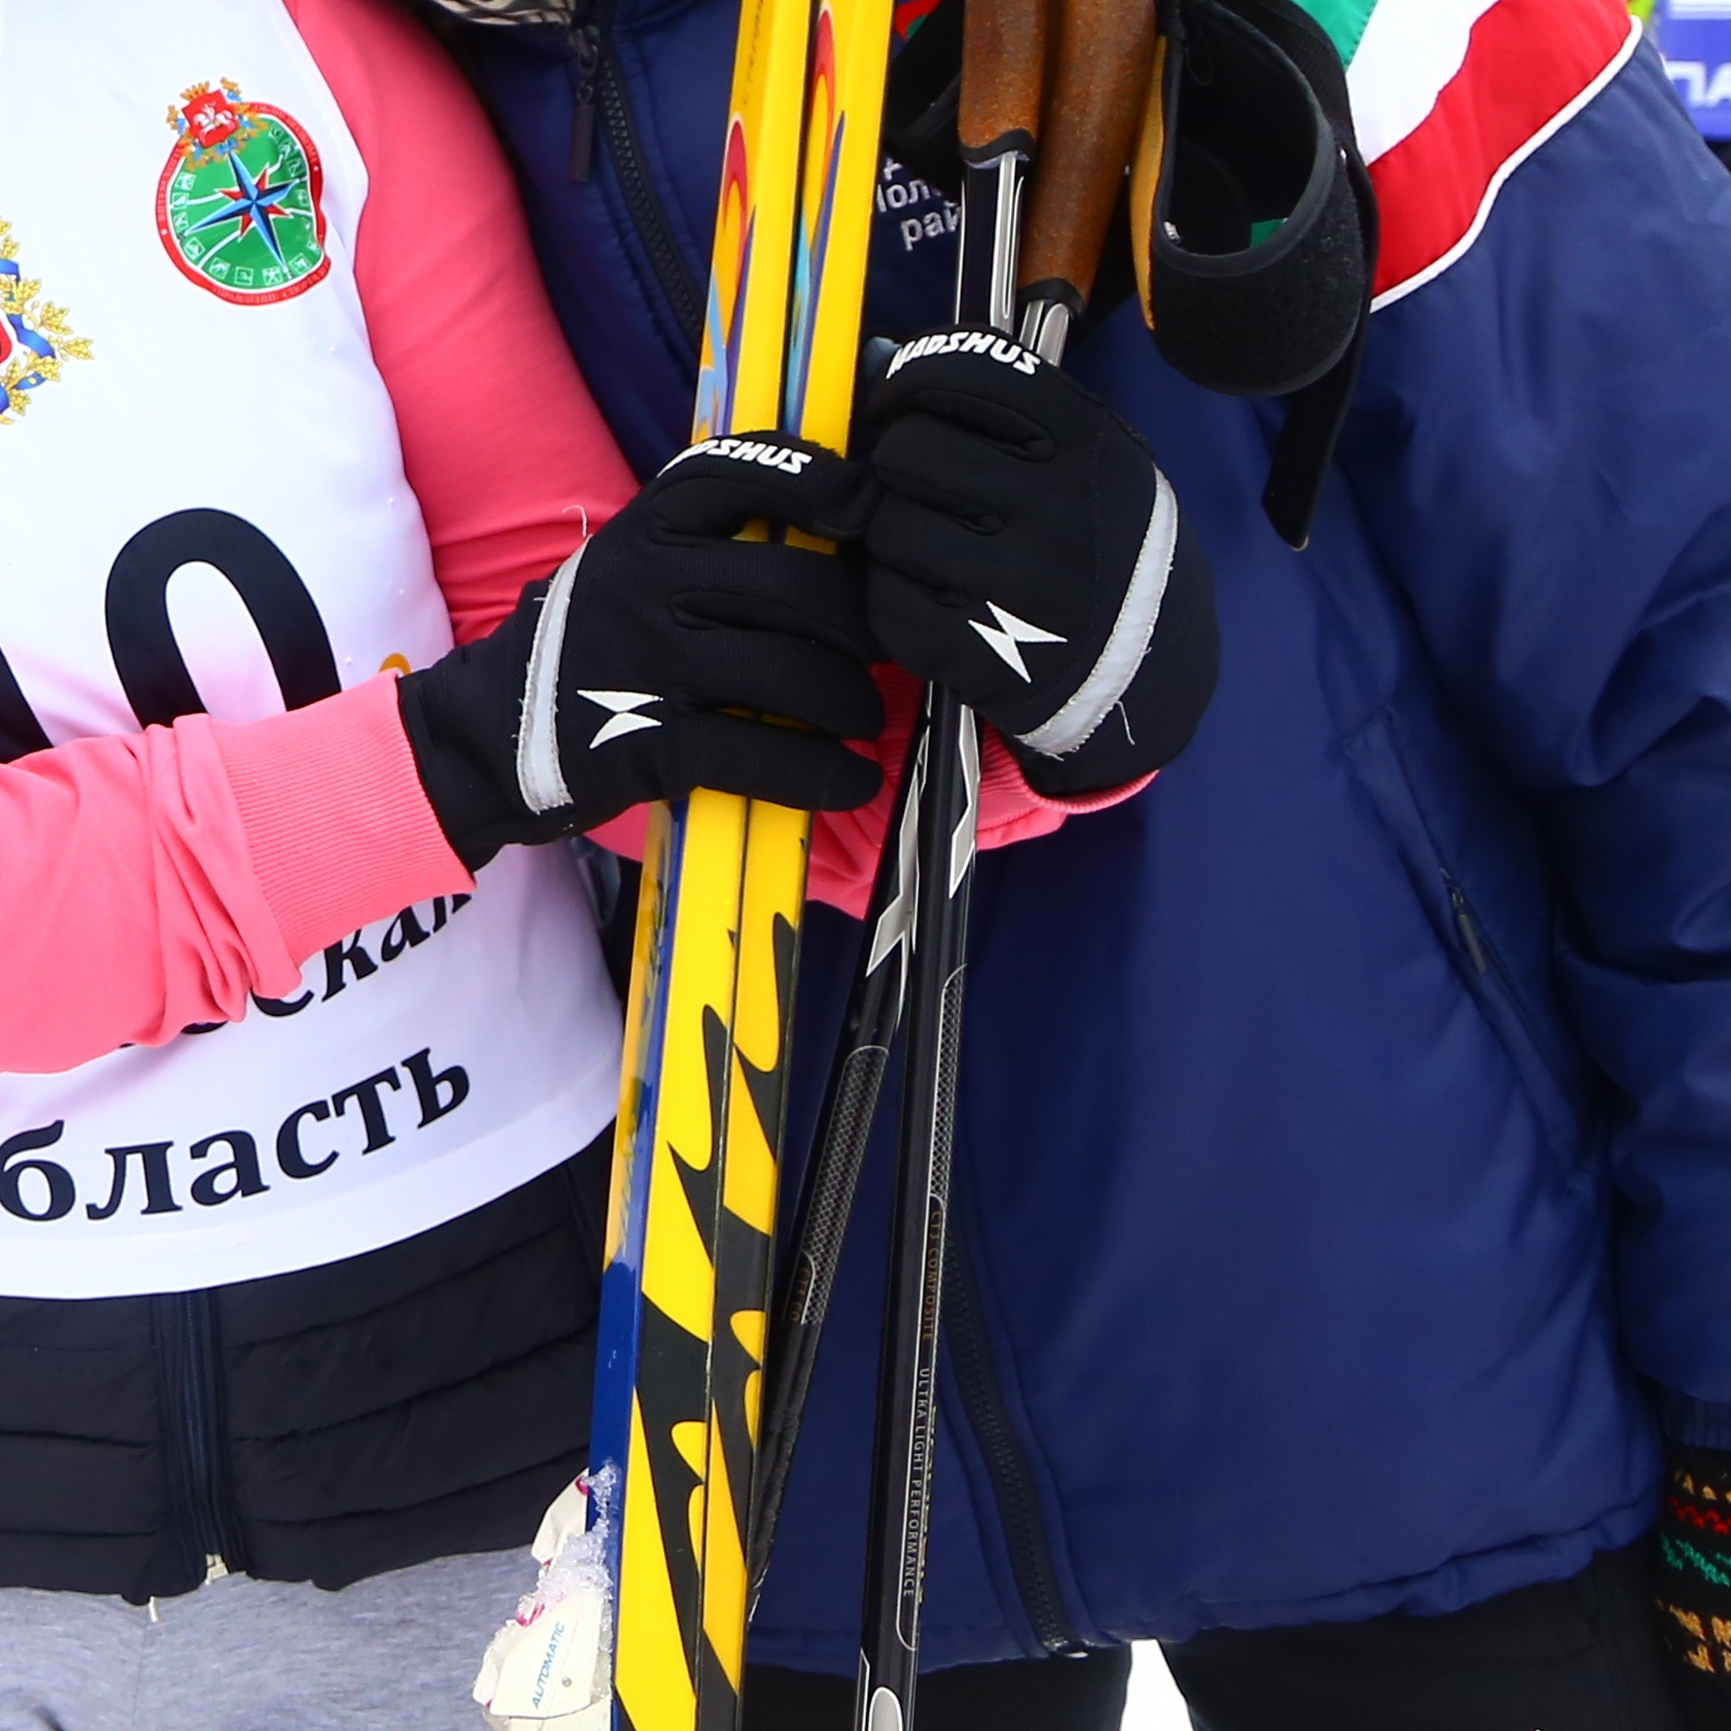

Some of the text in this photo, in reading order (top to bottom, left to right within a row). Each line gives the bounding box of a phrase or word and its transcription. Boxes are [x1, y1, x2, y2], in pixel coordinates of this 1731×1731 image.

[885, 330, 1042, 380] MADSHUS
[917, 1367, 933, 1415] ULTRA
[912, 1419, 928, 1475] LIGHT
[902, 1477, 926, 1600] PERFORMANCE
[532, 1621, 567, 1710] AUTOMATIC
